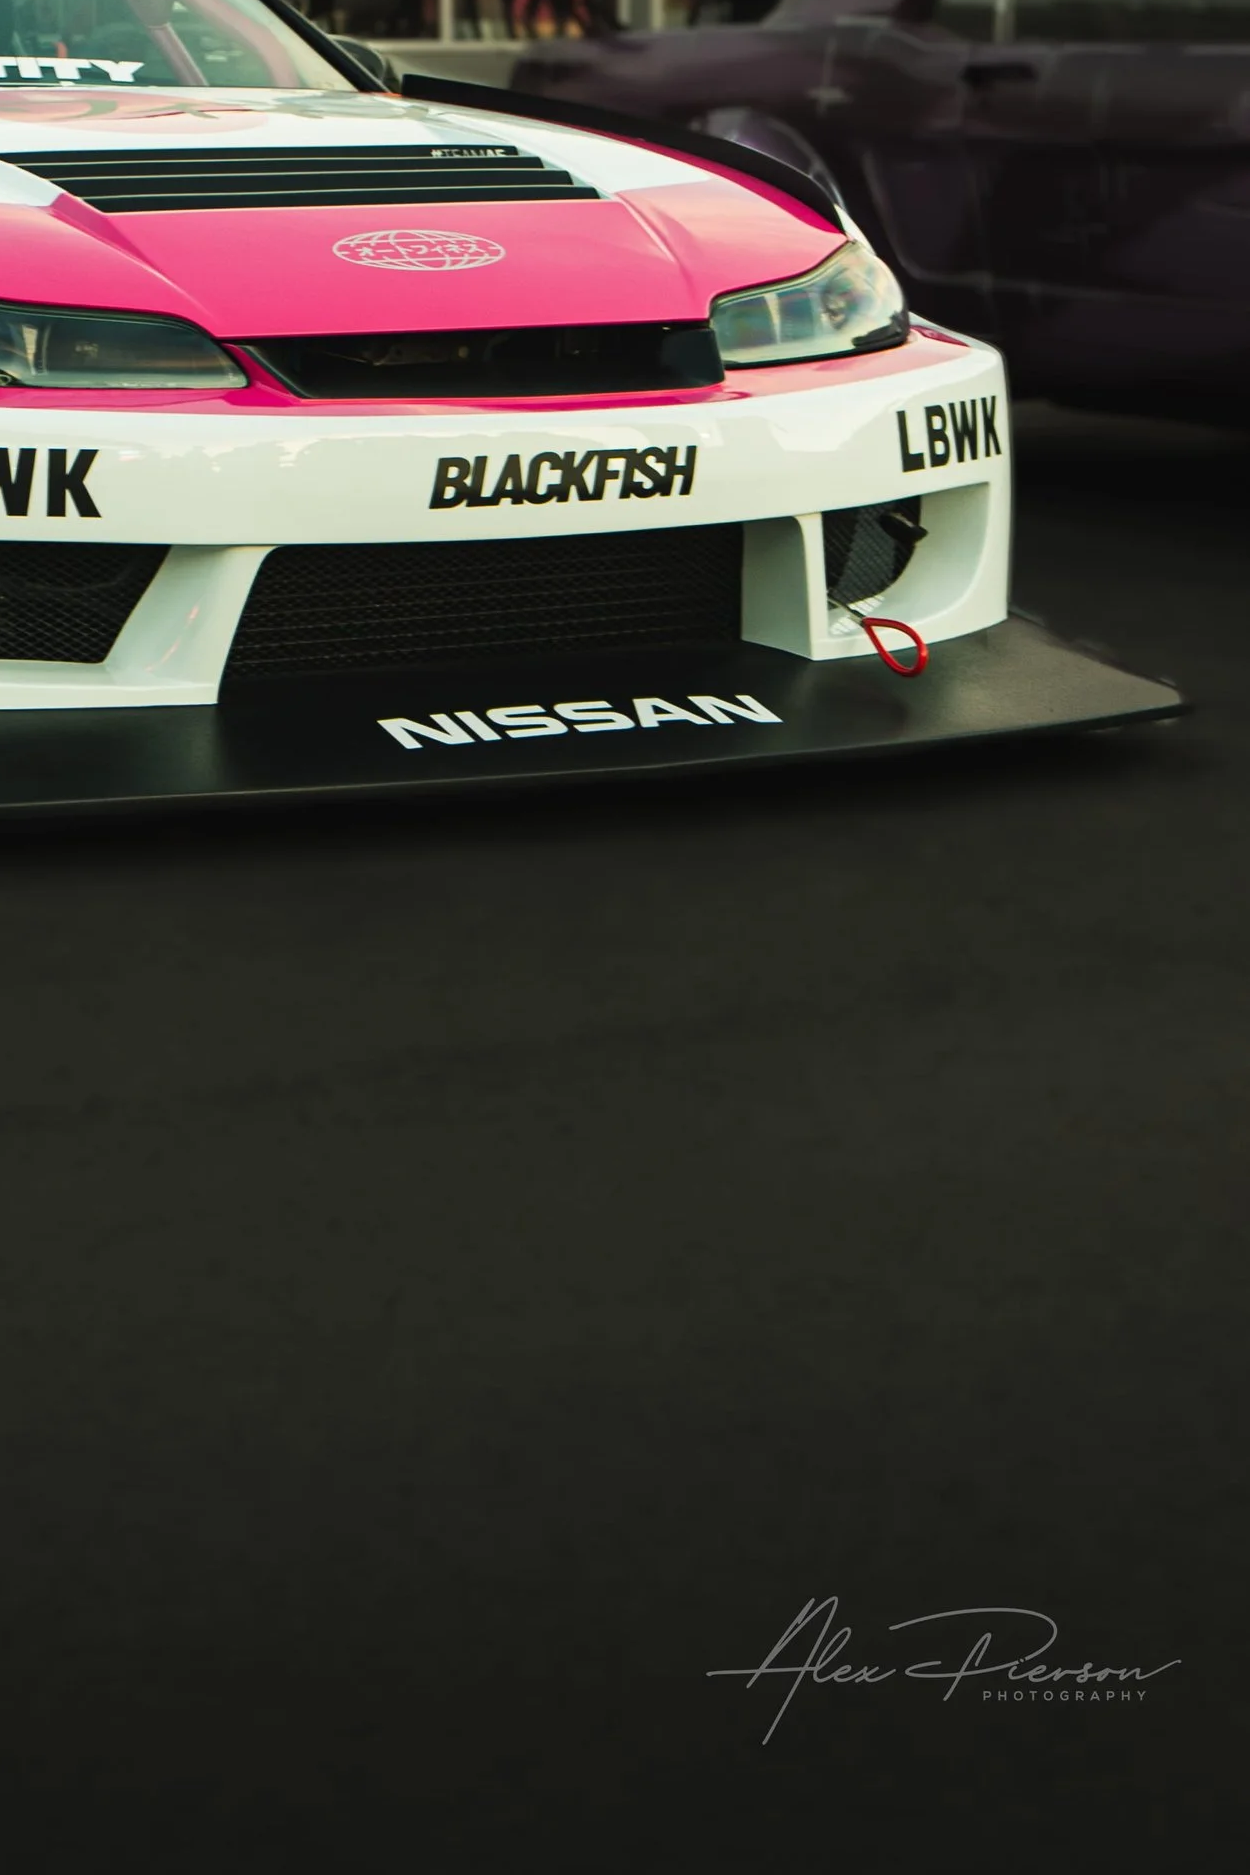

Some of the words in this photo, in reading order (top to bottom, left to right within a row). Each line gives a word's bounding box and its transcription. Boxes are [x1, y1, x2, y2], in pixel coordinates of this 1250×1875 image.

[896, 395, 1003, 474] LBWK
[428, 445, 698, 511] BLACKFISH
[376, 694, 783, 752] NISSAN
